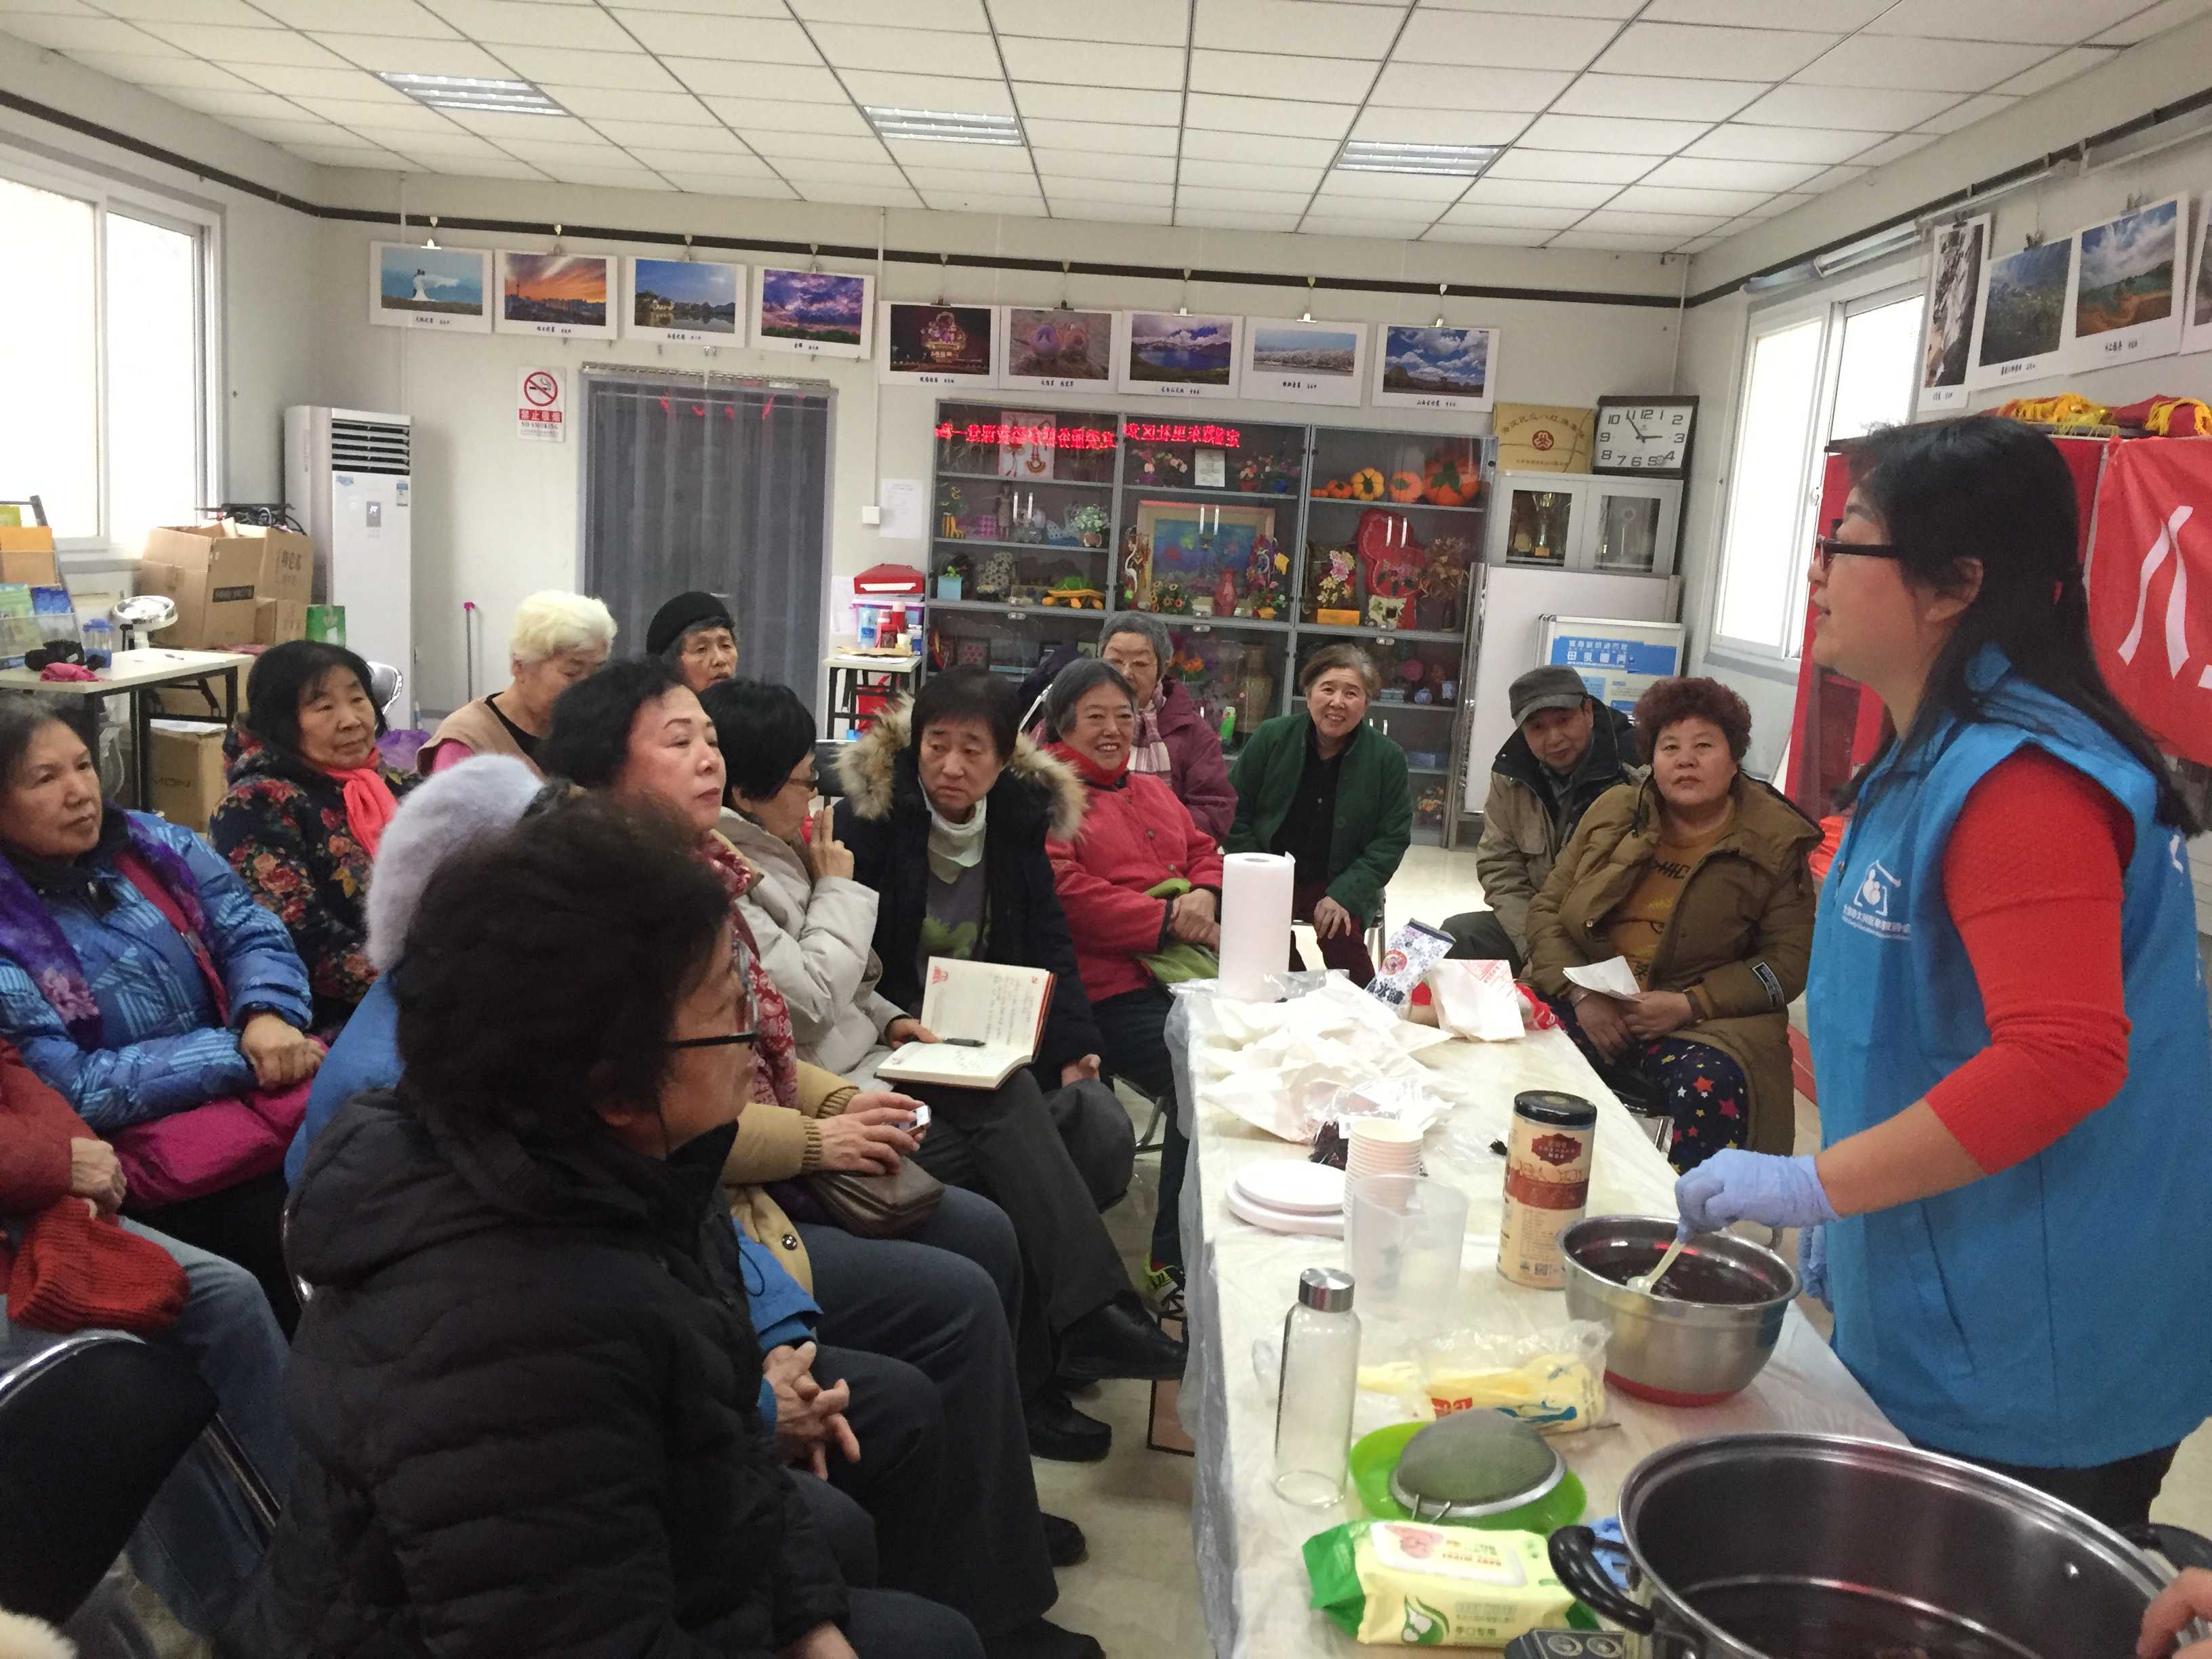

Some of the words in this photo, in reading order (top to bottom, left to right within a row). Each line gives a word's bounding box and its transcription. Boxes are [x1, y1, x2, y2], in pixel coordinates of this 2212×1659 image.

[1640, 409, 1654, 419] 12
[1608, 415, 1620, 424] 10
[1672, 415, 1683, 425] 2
[1600, 432, 1610, 442] 9
[1674, 433, 1685, 443] 3
[1601, 450, 1612, 459] 8
[1664, 451, 1675, 461] 4
[1618, 455, 1626, 466] 7
[1631, 457, 1642, 466] 6
[1647, 456, 1658, 466] 5
